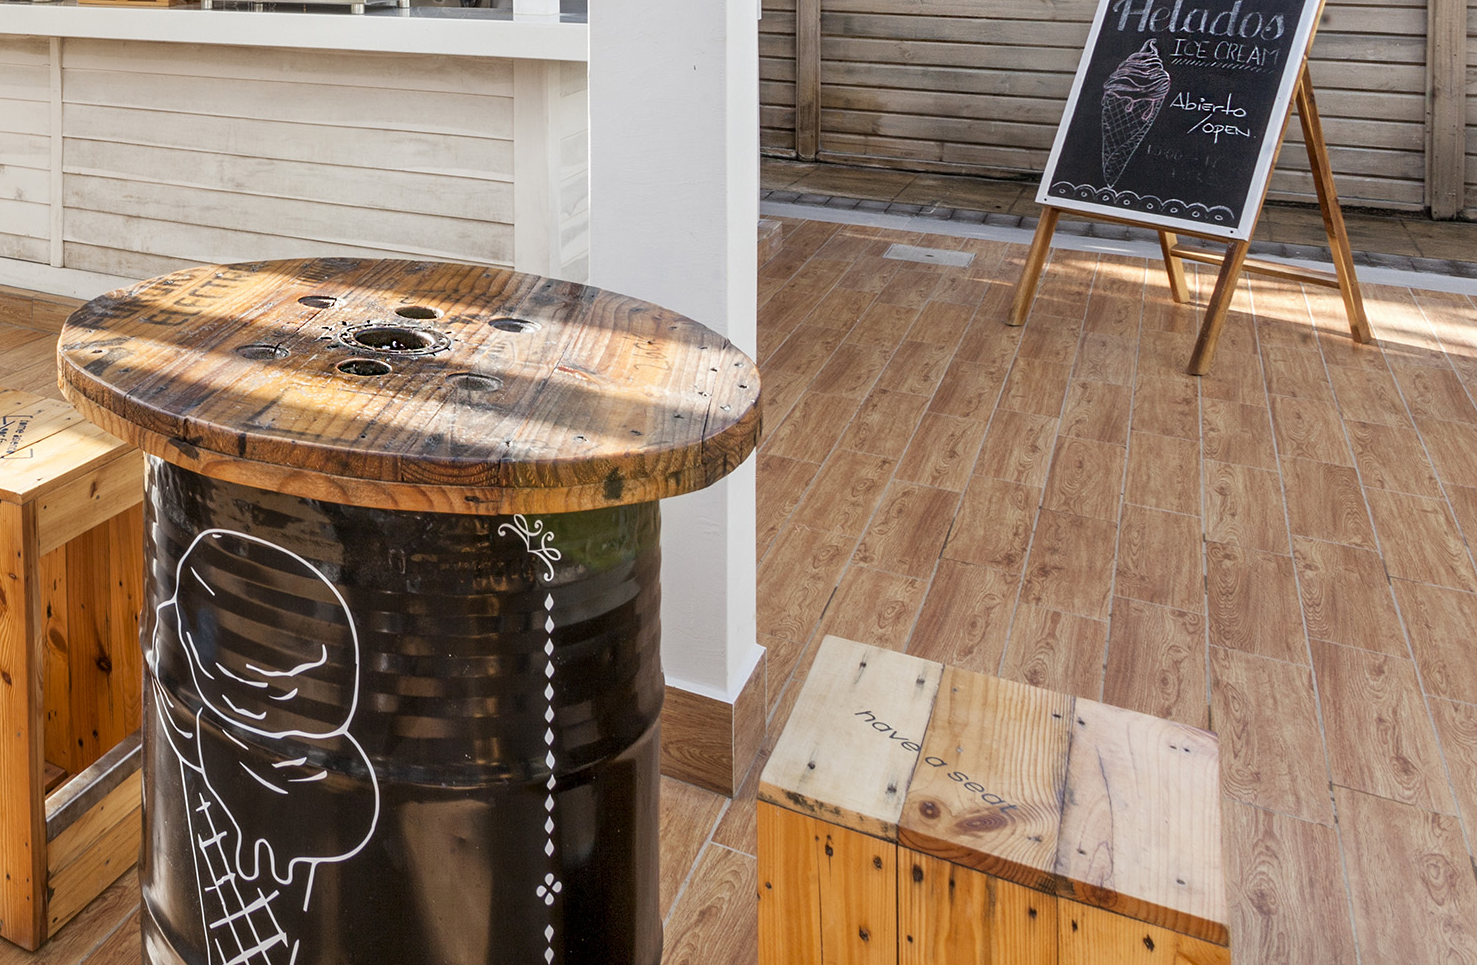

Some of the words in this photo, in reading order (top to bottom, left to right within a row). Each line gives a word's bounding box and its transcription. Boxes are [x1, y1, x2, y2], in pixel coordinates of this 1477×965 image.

[1169, 38, 1210, 59] ICE
[1213, 40, 1281, 66] CREAM
[1169, 91, 1247, 118] Abierto
[925, 756, 948, 768] a
[947, 770, 1019, 815] seat
